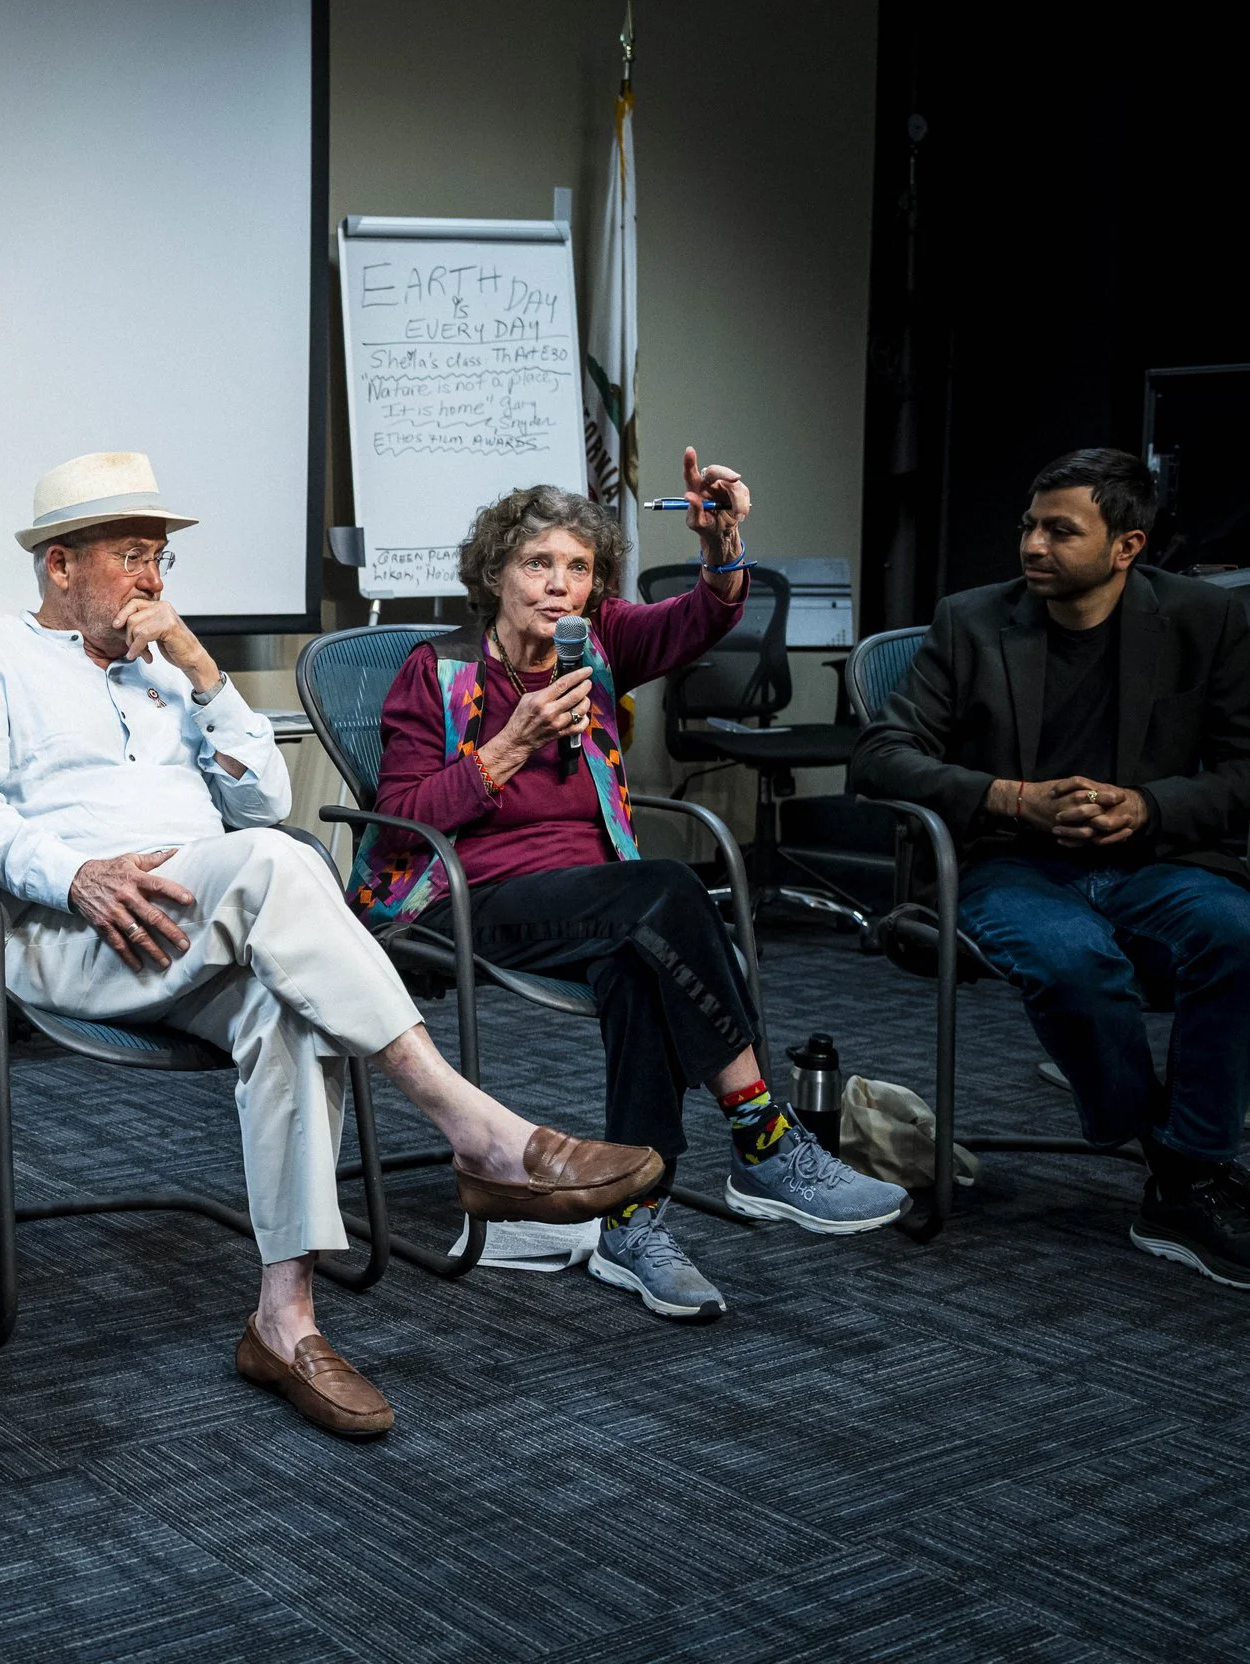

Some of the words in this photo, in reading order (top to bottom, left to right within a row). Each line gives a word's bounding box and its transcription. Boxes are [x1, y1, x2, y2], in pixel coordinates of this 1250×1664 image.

[362, 263, 502, 308] EARTH
[504, 276, 558, 323] DAY
[405, 318, 483, 342] EVERY
[494, 317, 539, 341] DAY
[446, 352, 481, 369] class
[437, 381, 451, 394] is
[455, 376, 485, 392] not
[492, 377, 503, 388] a
[381, 403, 414, 418] It
[417, 405, 434, 417] is
[472, 434, 539, 450] AWARDS
